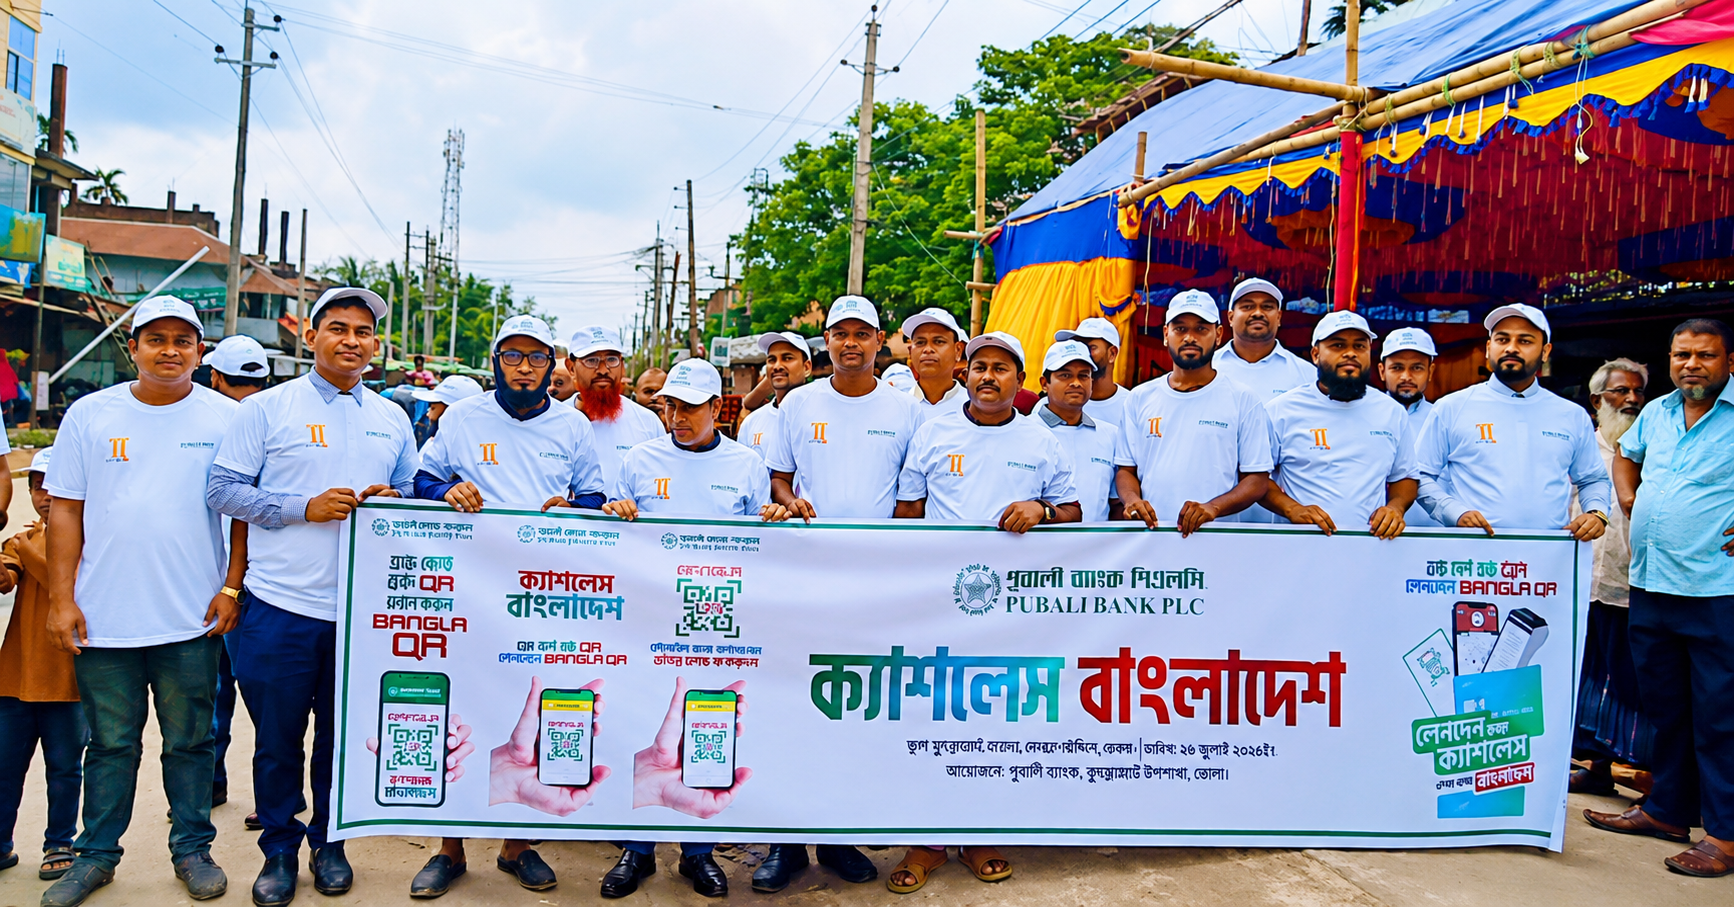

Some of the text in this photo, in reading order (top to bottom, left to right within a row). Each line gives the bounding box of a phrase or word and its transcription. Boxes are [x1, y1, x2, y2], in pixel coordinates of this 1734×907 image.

[419, 574, 455, 593] QR
[518, 570, 615, 594] ক্যাশলেস
[1460, 580, 1531, 596] BANGLA
[1534, 582, 1557, 598] QR
[1006, 596, 1205, 616] PUBALI BANK PLC
[372, 614, 467, 632] BANGLA
[392, 632, 447, 661] QR
[580, 642, 601, 653] QR
[544, 653, 603, 665] BANGLA
[606, 655, 628, 666] QR
[809, 645, 1347, 728] ক্যাশলেস বাংলাদেশ
[1437, 734, 1527, 771] ক্যাশলেস
[946, 765, 1005, 778] আয়োজনে:
[1046, 766, 1083, 780] ব্যাংক,
